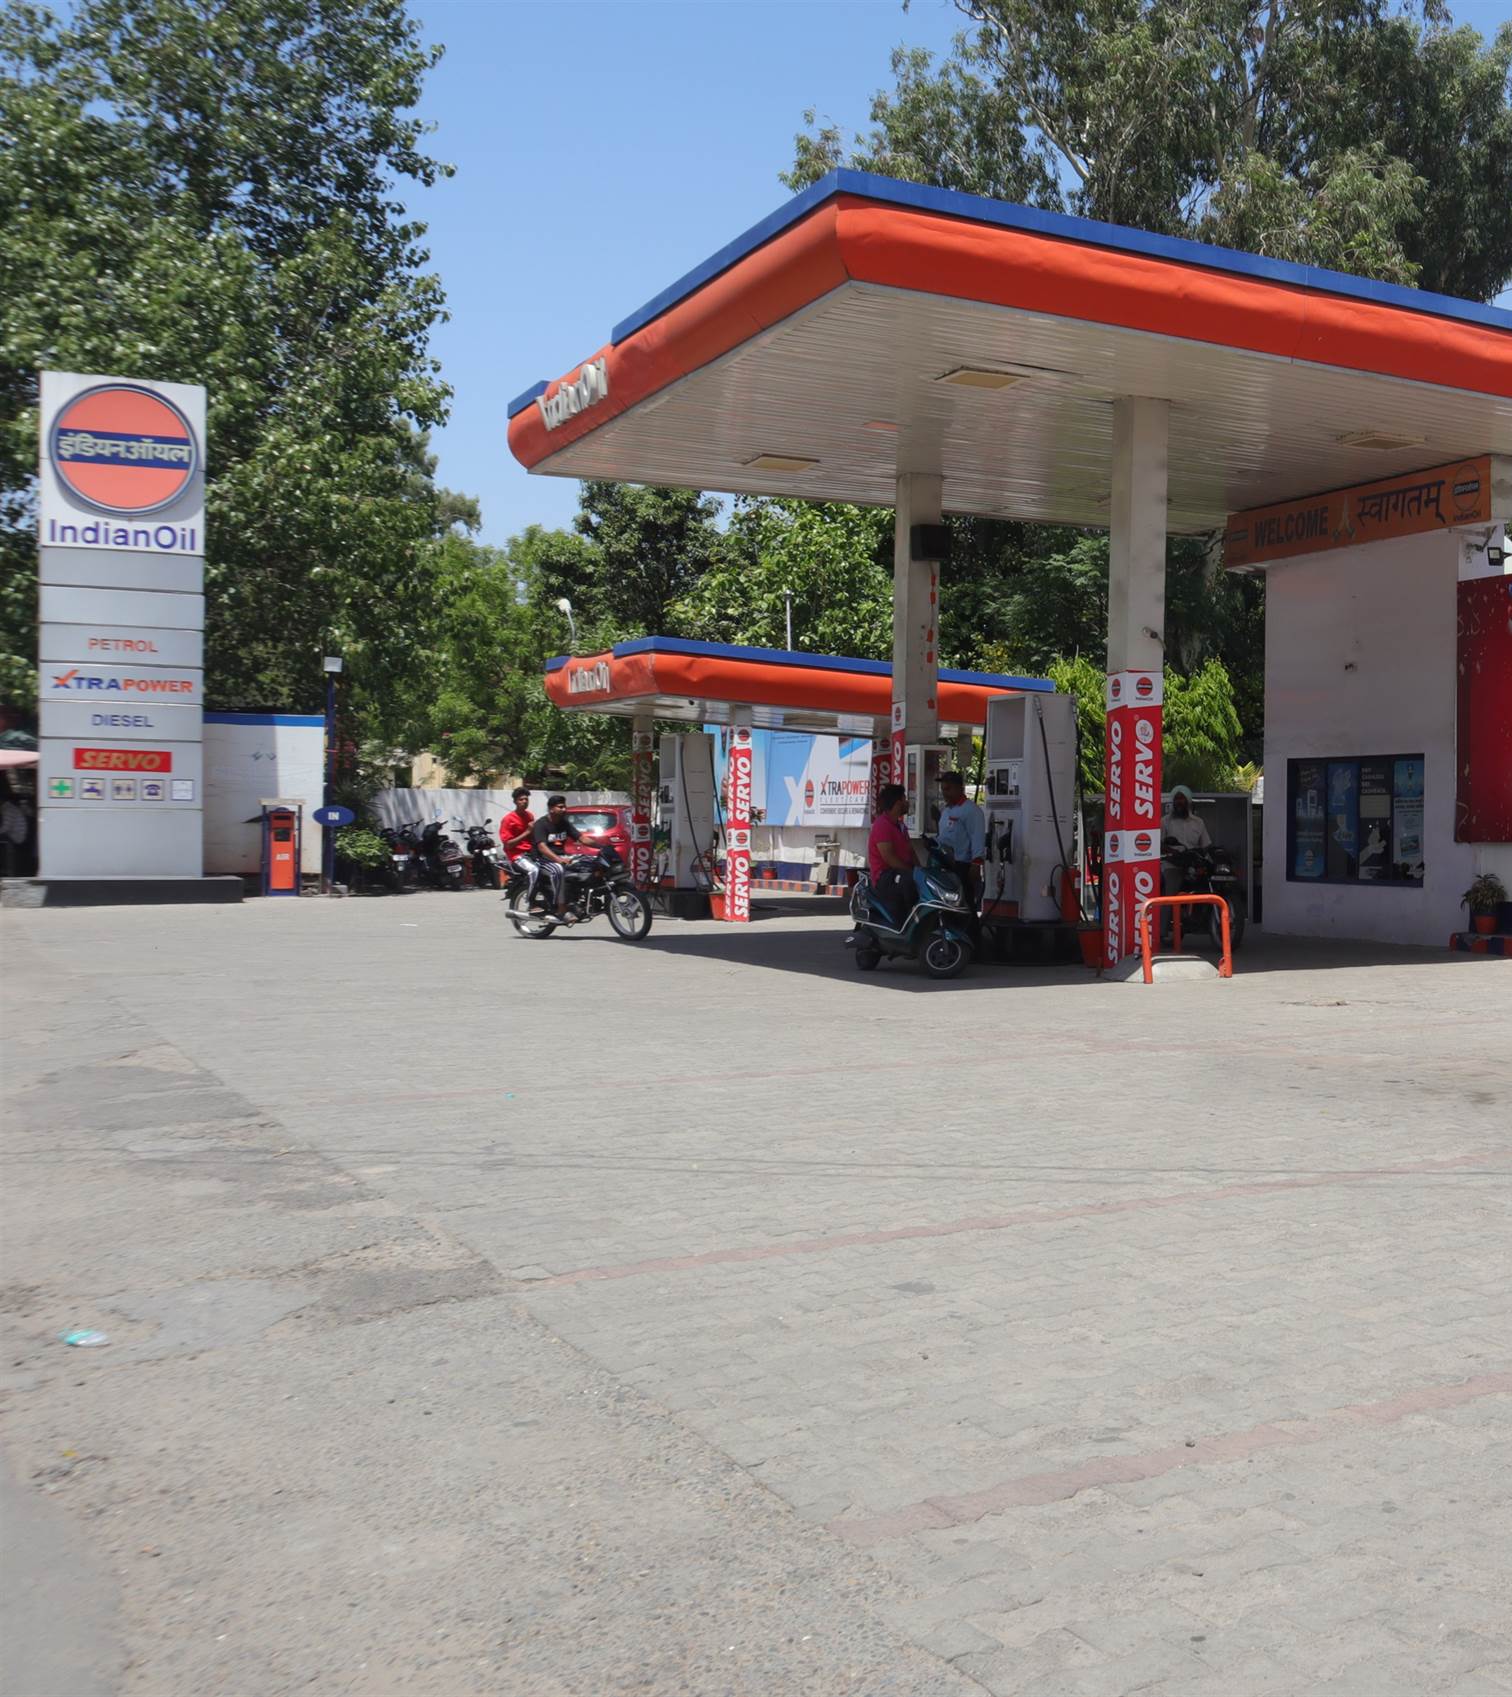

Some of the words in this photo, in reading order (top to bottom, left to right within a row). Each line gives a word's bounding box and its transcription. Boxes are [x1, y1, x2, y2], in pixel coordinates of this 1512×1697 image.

[58, 433, 191, 462] इंडियनऑयल
[1357, 480, 1446, 527] स्वागतम्
[50, 519, 196, 550] IndianOil
[1255, 506, 1329, 548] WELCOME
[88, 638, 158, 653] PETROL
[52, 669, 193, 693] XTRAPOWER
[91, 714, 155, 728] DIESEL
[80, 751, 161, 770] SERVO
[1110, 720, 1122, 820] SERVO
[1134, 719, 1154, 819] SERVO
[735, 756, 751, 823] SERVO
[328, 811, 340, 821] IN
[734, 856, 749, 918] SERVO
[1108, 872, 1119, 964] SERVO
[1134, 871, 1153, 957] ERVO
